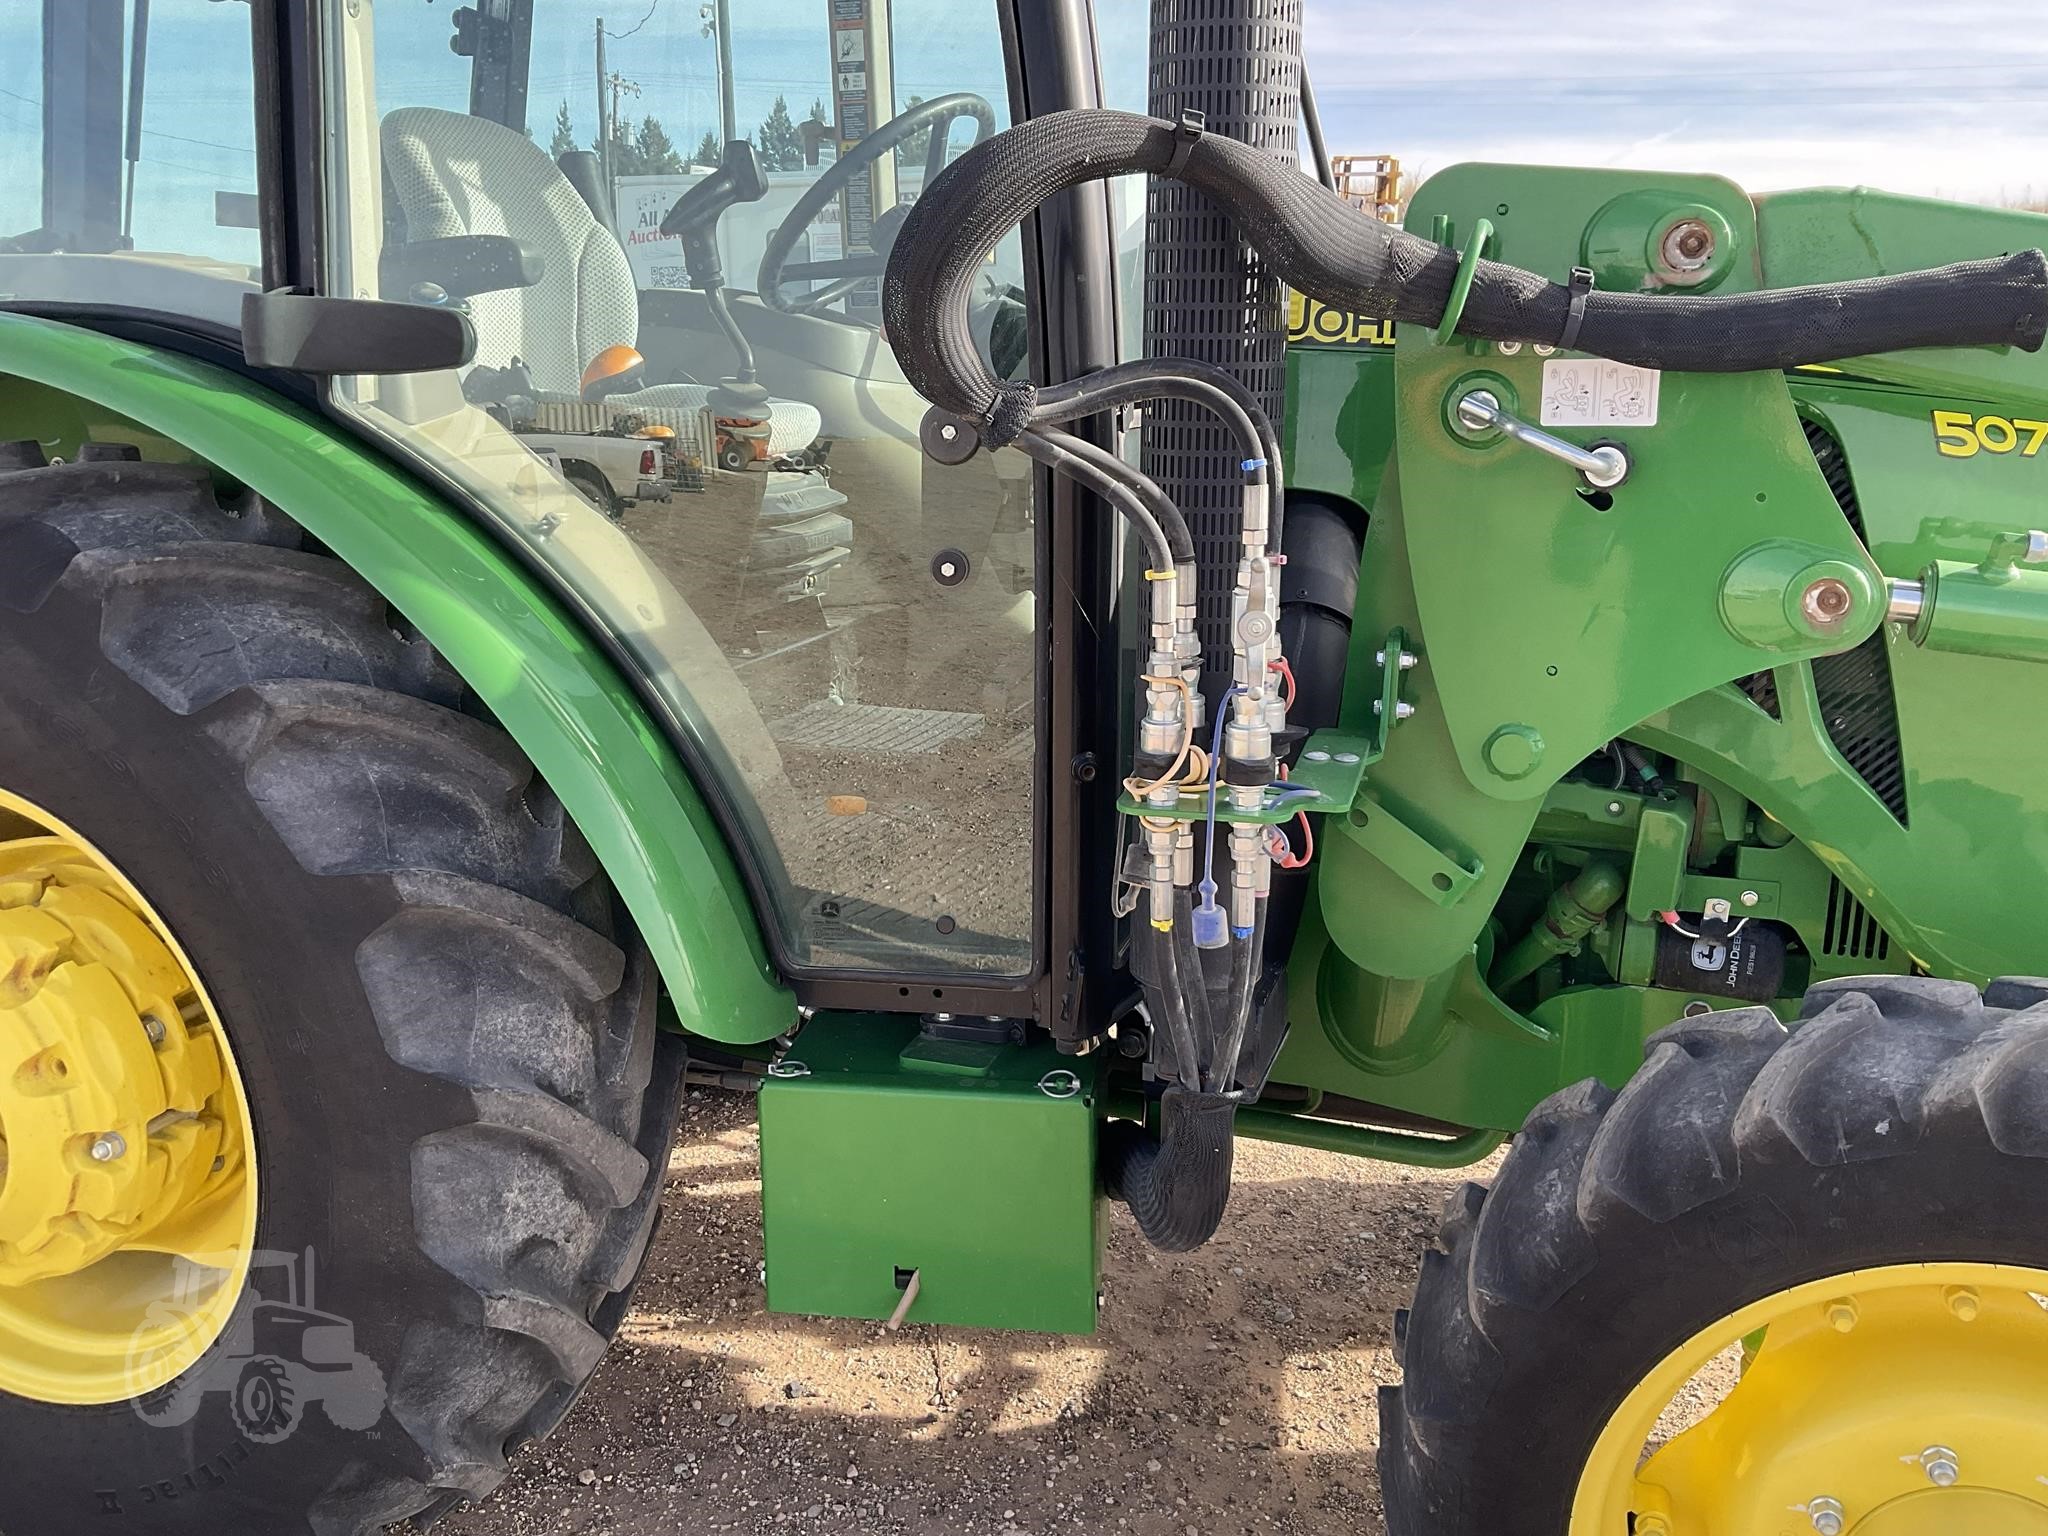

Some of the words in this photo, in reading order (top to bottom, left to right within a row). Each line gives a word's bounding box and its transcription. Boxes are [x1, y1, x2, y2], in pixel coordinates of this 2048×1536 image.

[638, 211, 658, 228] All
[1931, 409, 2048, 458] 507
[1727, 960, 1739, 987] JOHN
